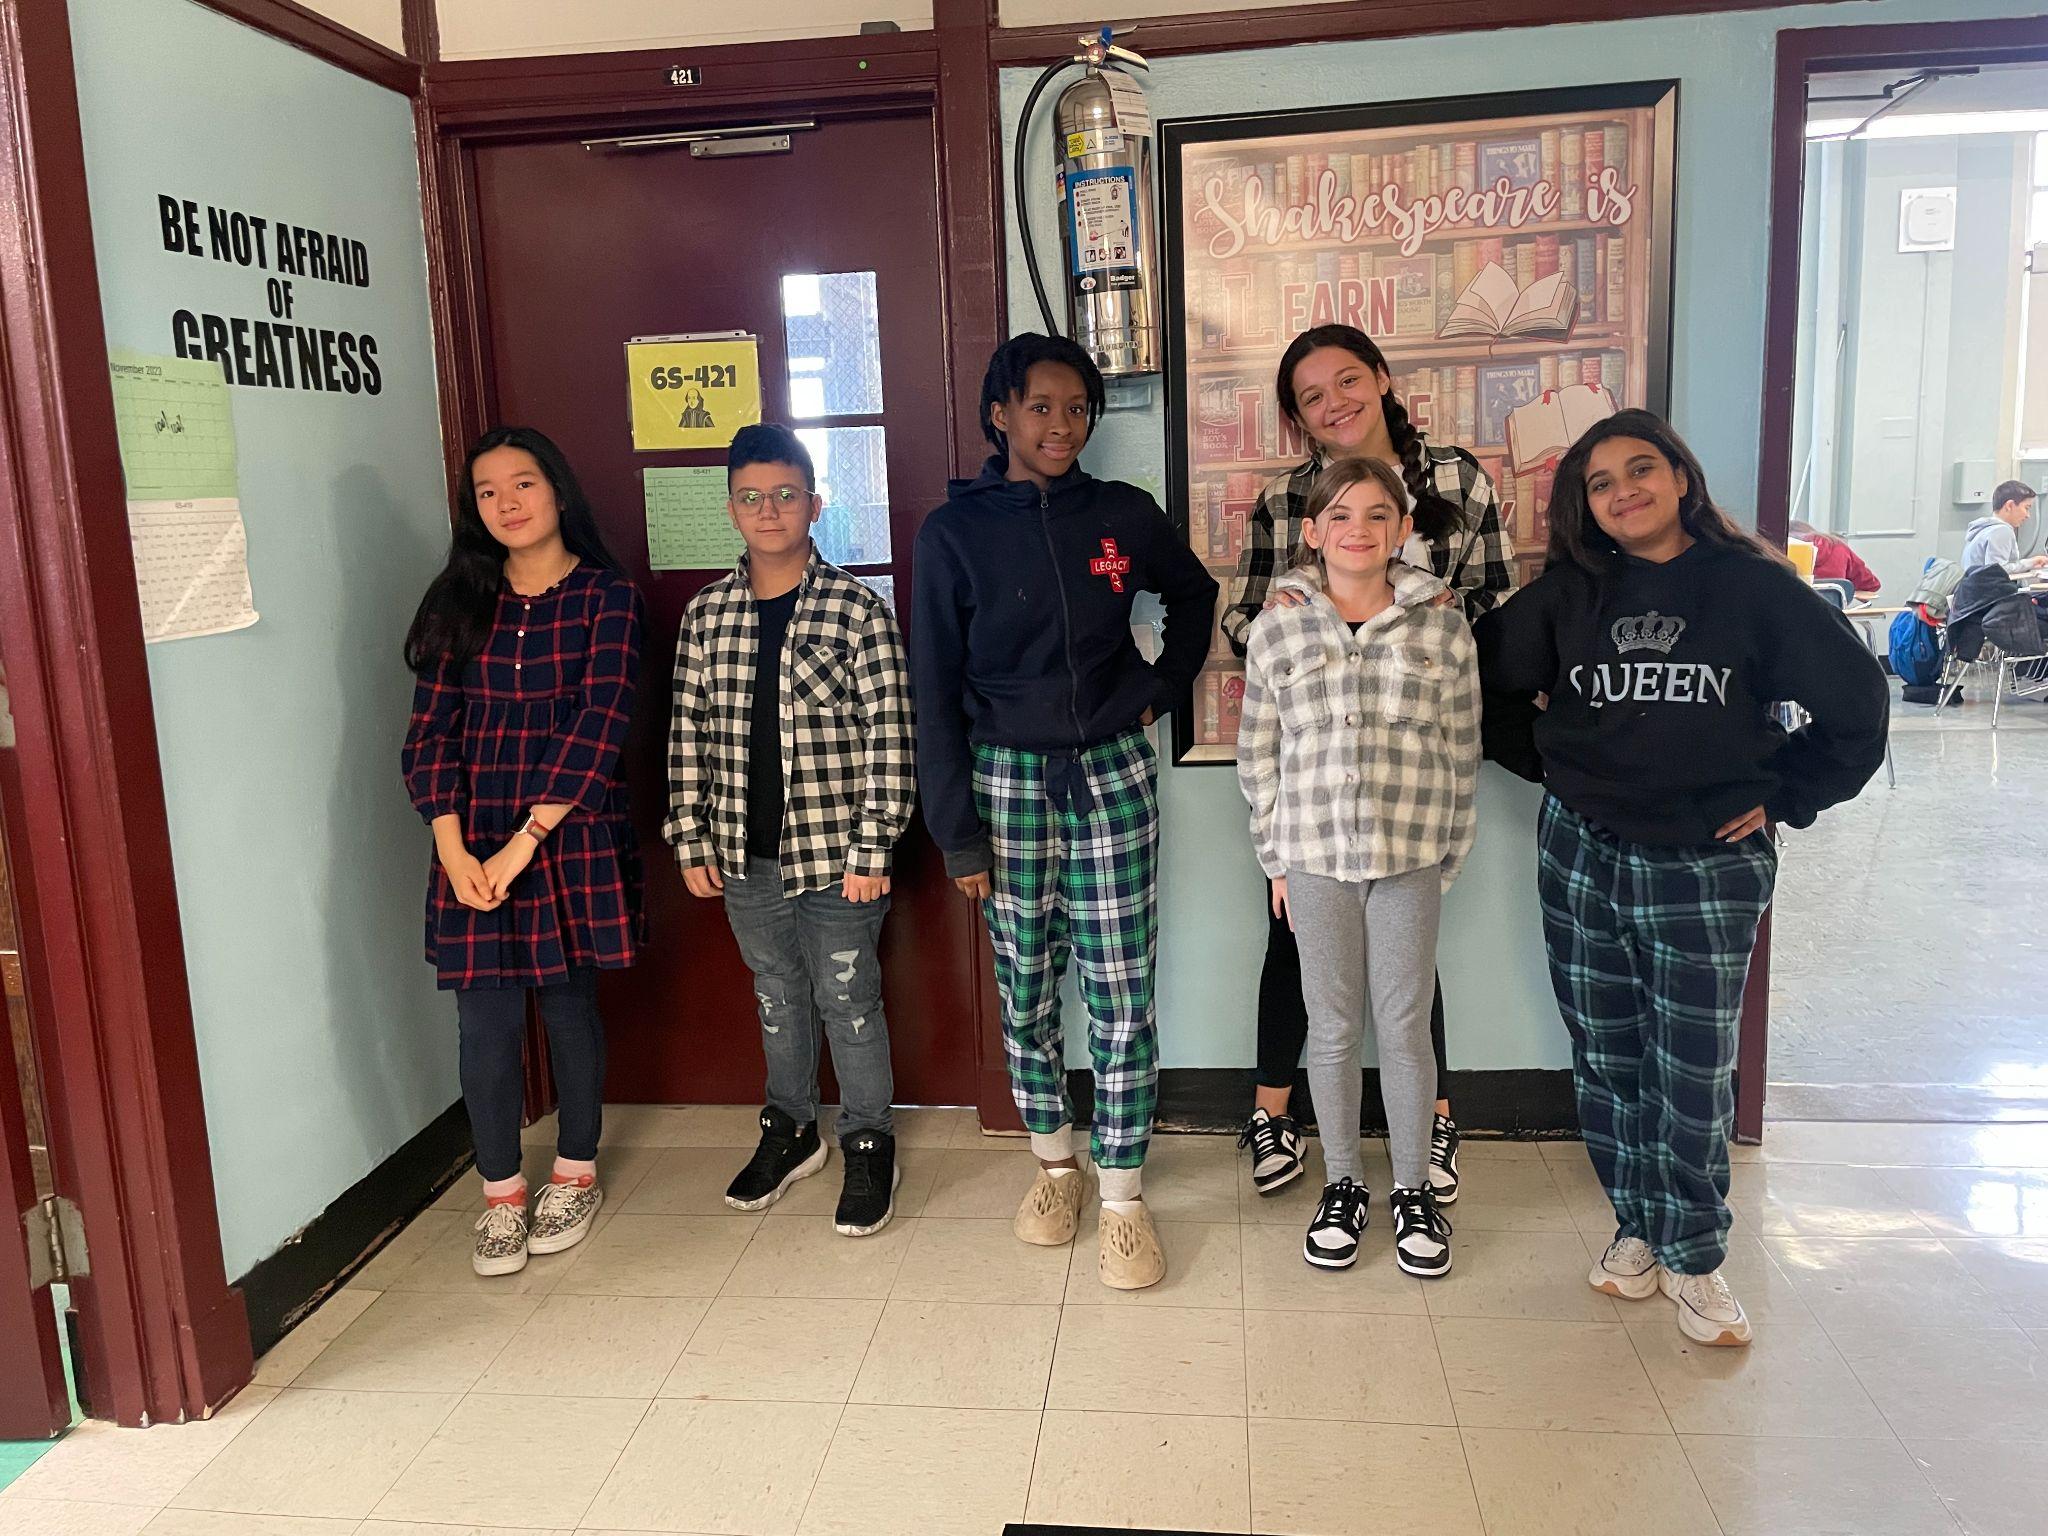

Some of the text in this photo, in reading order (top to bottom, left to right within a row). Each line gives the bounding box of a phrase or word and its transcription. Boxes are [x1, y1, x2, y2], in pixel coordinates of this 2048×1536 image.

[670, 69, 694, 85] 421
[1073, 175, 1126, 188] INSTRUCTIONS
[1193, 166, 1638, 258] Shakespeare is
[157, 193, 370, 288] BE NOT AFRAID
[1110, 274, 1135, 282] Badger
[266, 277, 294, 319] OF
[172, 308, 383, 396] GREATNESS
[109, 362, 144, 374] November
[650, 364, 737, 391] 6S-421
[1095, 561, 1128, 572] LEGACY
[1569, 662, 1732, 708] QUEEN
